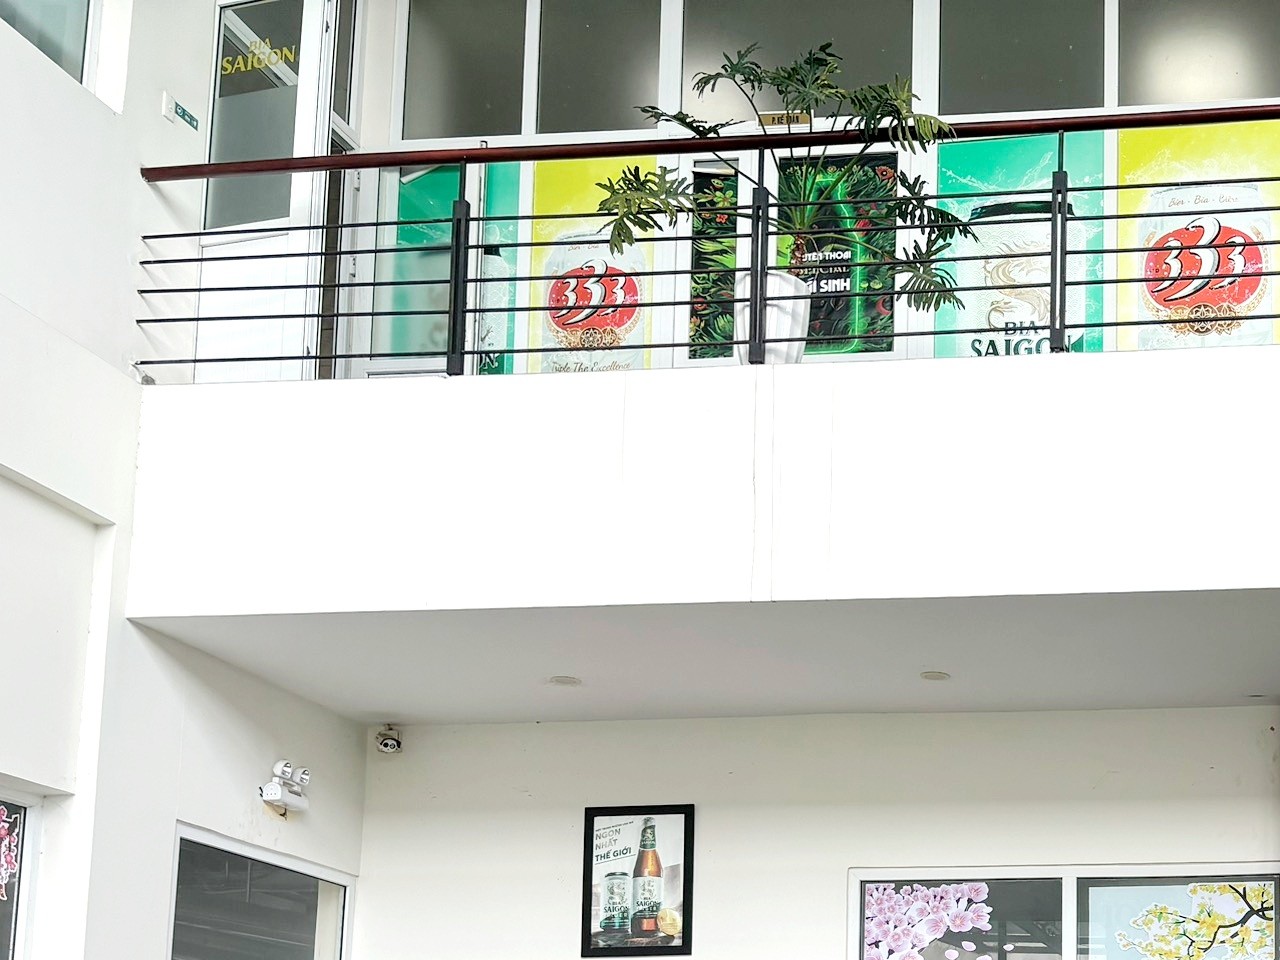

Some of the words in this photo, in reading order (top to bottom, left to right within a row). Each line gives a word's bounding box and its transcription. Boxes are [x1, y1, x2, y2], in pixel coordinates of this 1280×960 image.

[249, 38, 271, 51] BIA
[222, 45, 295, 74] SAIGON
[1194, 195, 1208, 205] Bia
[1151, 216, 1246, 302] 333
[553, 258, 627, 326] 333
[820, 277, 850, 293] SINH
[1004, 320, 1040, 336] BIA
[574, 362, 589, 372] The
[591, 360, 631, 372] Excellence
[595, 849, 612, 861] THẾ
[613, 846, 632, 858] GIỚI
